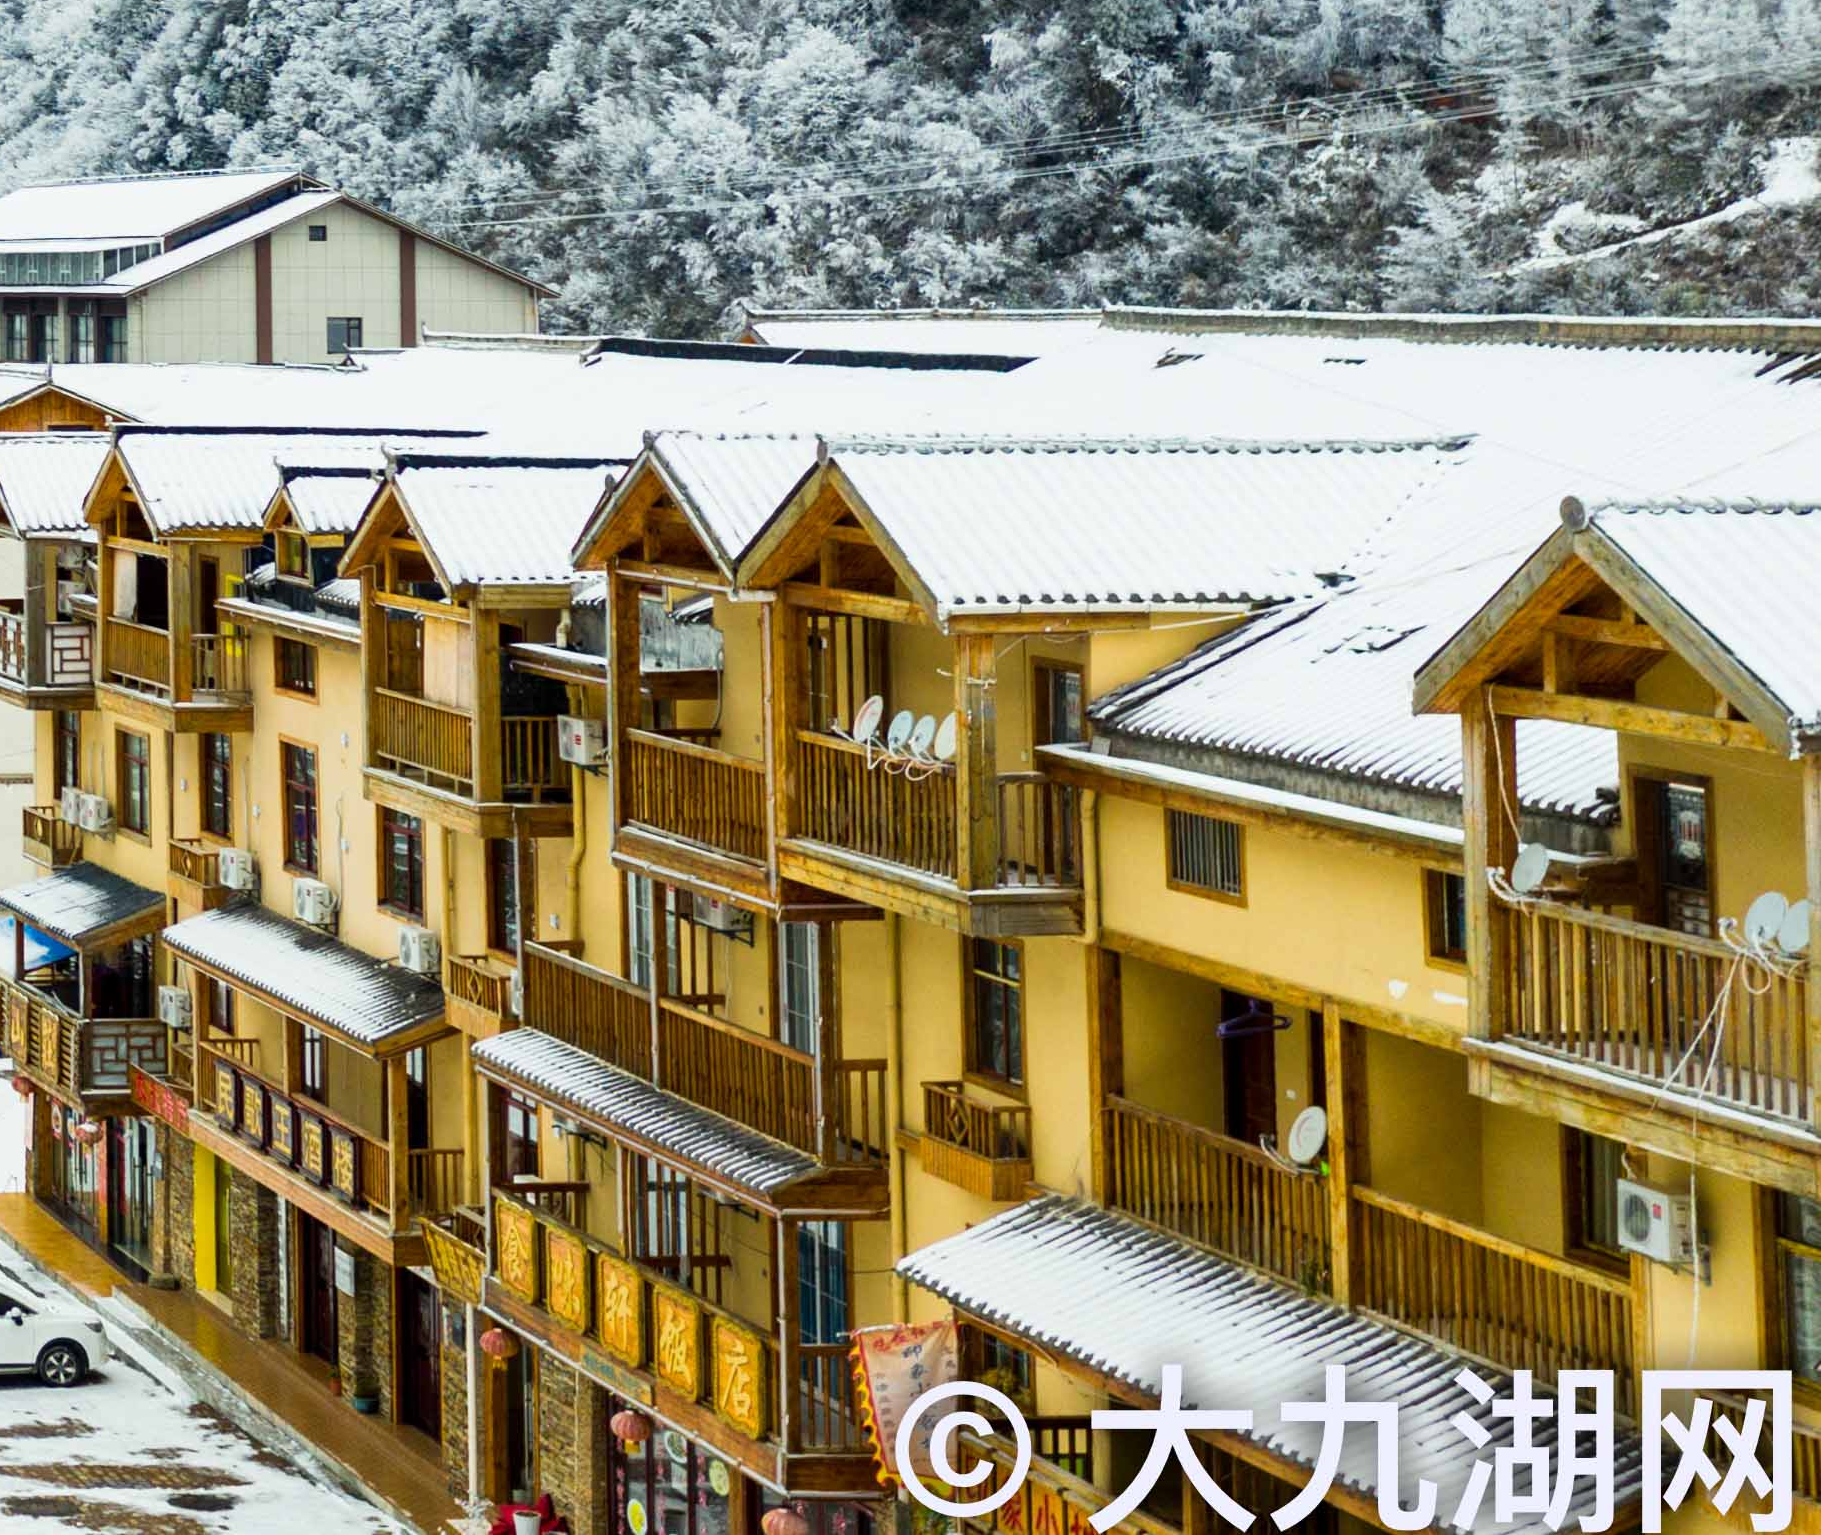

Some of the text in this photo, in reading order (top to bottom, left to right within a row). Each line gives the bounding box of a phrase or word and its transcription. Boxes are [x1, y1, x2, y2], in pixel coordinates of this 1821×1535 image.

[216, 1069, 355, 1200] 民歌王酒楼
[502, 1224, 753, 1418] 食味轩饭店
